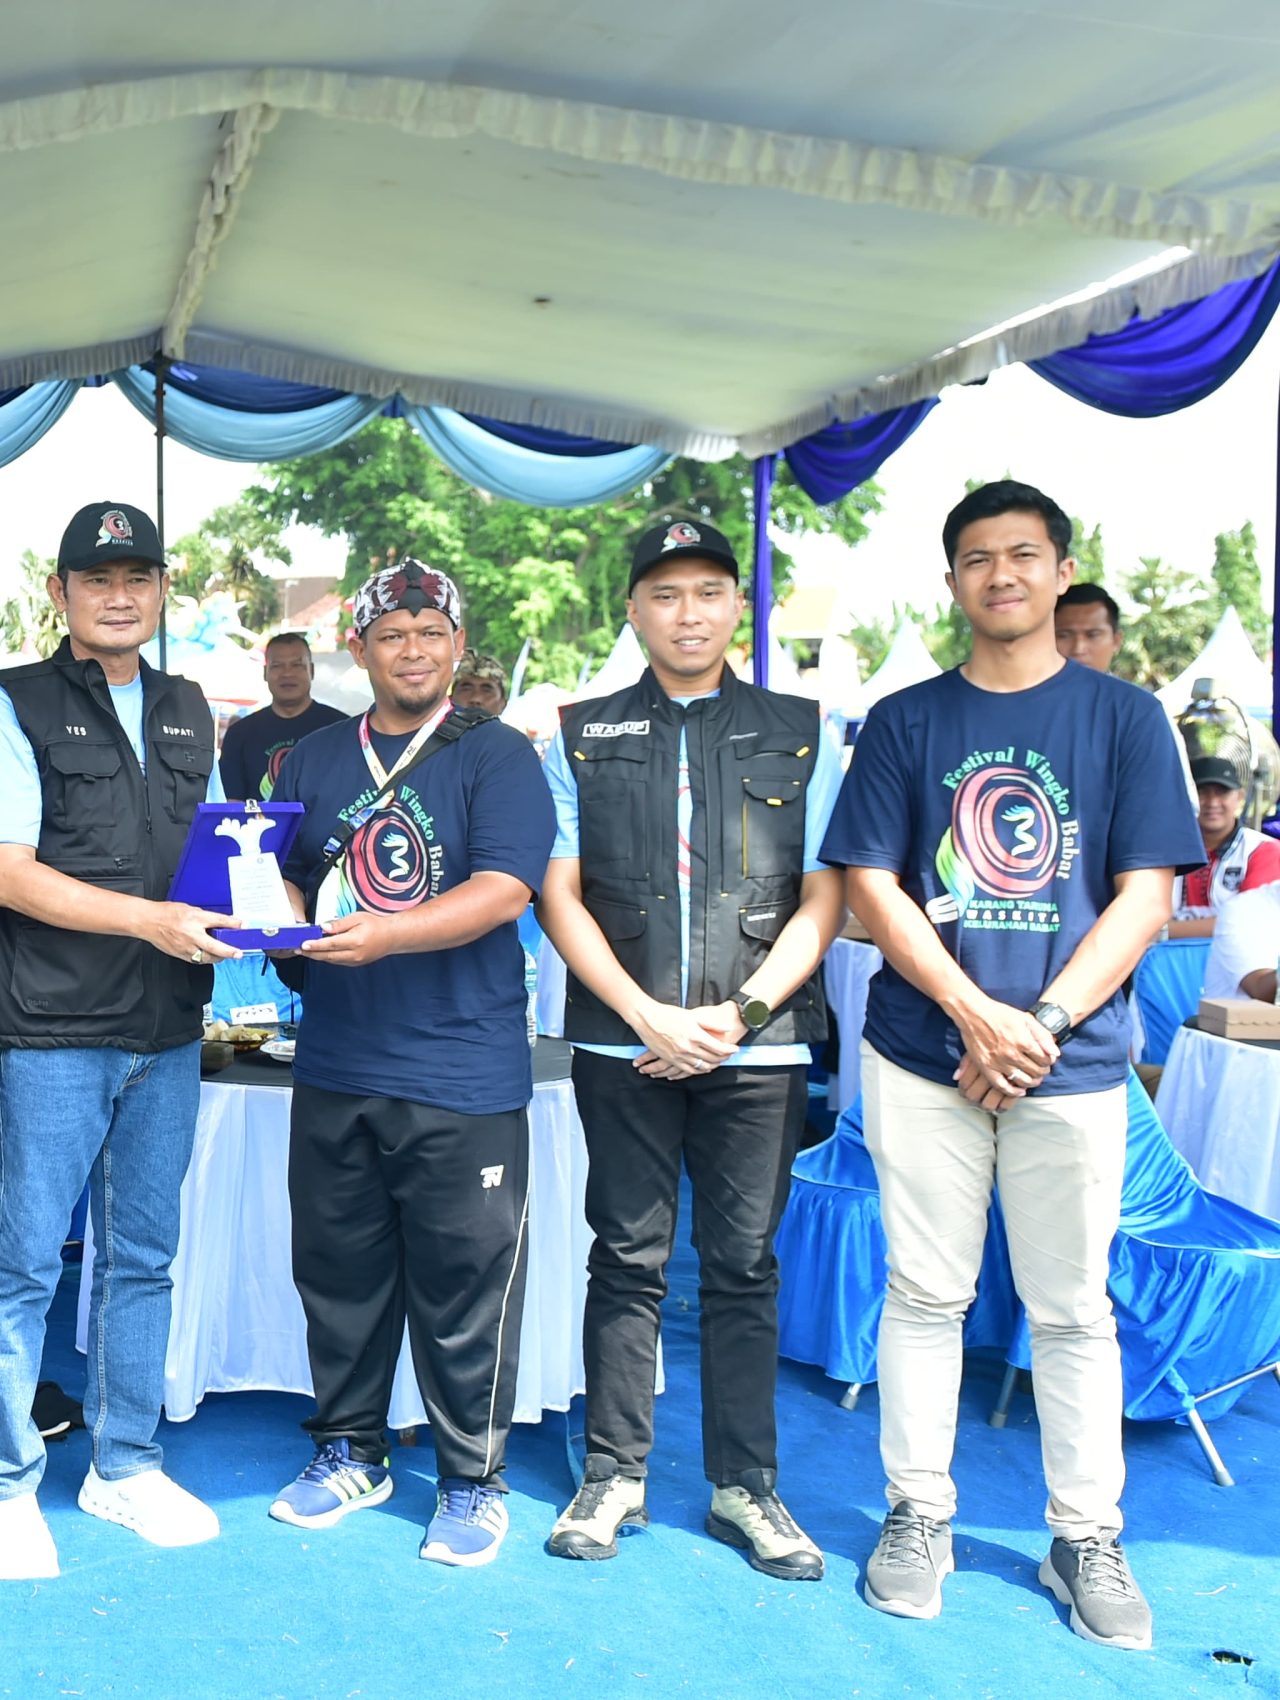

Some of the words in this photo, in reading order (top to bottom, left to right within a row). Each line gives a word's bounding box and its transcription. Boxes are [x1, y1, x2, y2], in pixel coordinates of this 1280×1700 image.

[65, 725, 87, 736] YES
[162, 725, 195, 738] BUPATI
[588, 723, 646, 736] WABUP
[399, 784, 436, 842] Wingko
[942, 746, 1015, 791] Festival
[1024, 749, 1071, 816] Wingko
[1055, 819, 1081, 881] Babat
[969, 900, 1015, 909] KARANG
[1016, 900, 1058, 912] TARUNA
[965, 909, 1060, 923] WASKITA
[963, 919, 1028, 931] KELURAHAN
[1029, 922, 1061, 932] BABAT
